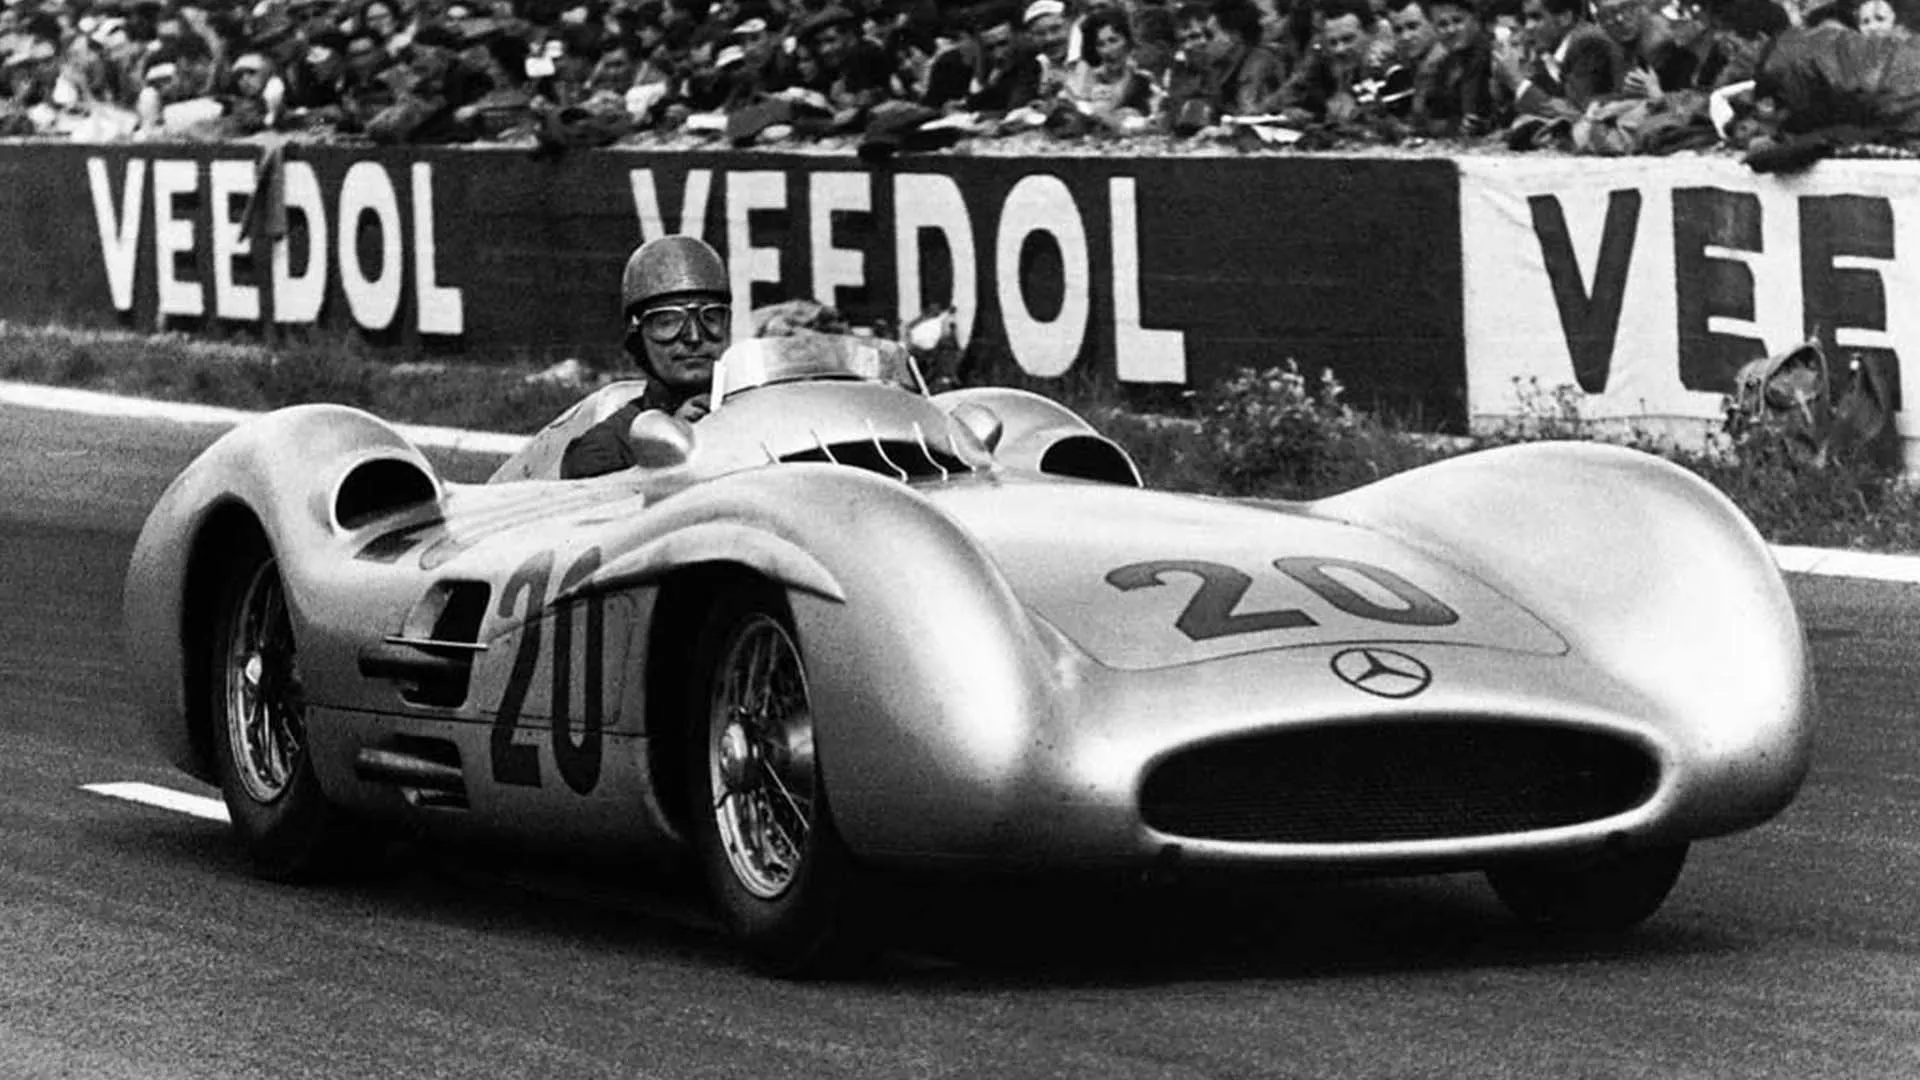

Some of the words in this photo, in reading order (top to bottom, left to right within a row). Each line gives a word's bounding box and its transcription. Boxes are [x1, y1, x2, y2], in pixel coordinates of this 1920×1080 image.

[87, 157, 464, 335] VEEDOL
[1528, 185, 1902, 412] VEE
[490, 545, 603, 796] 20
[1105, 556, 1459, 641] 20
